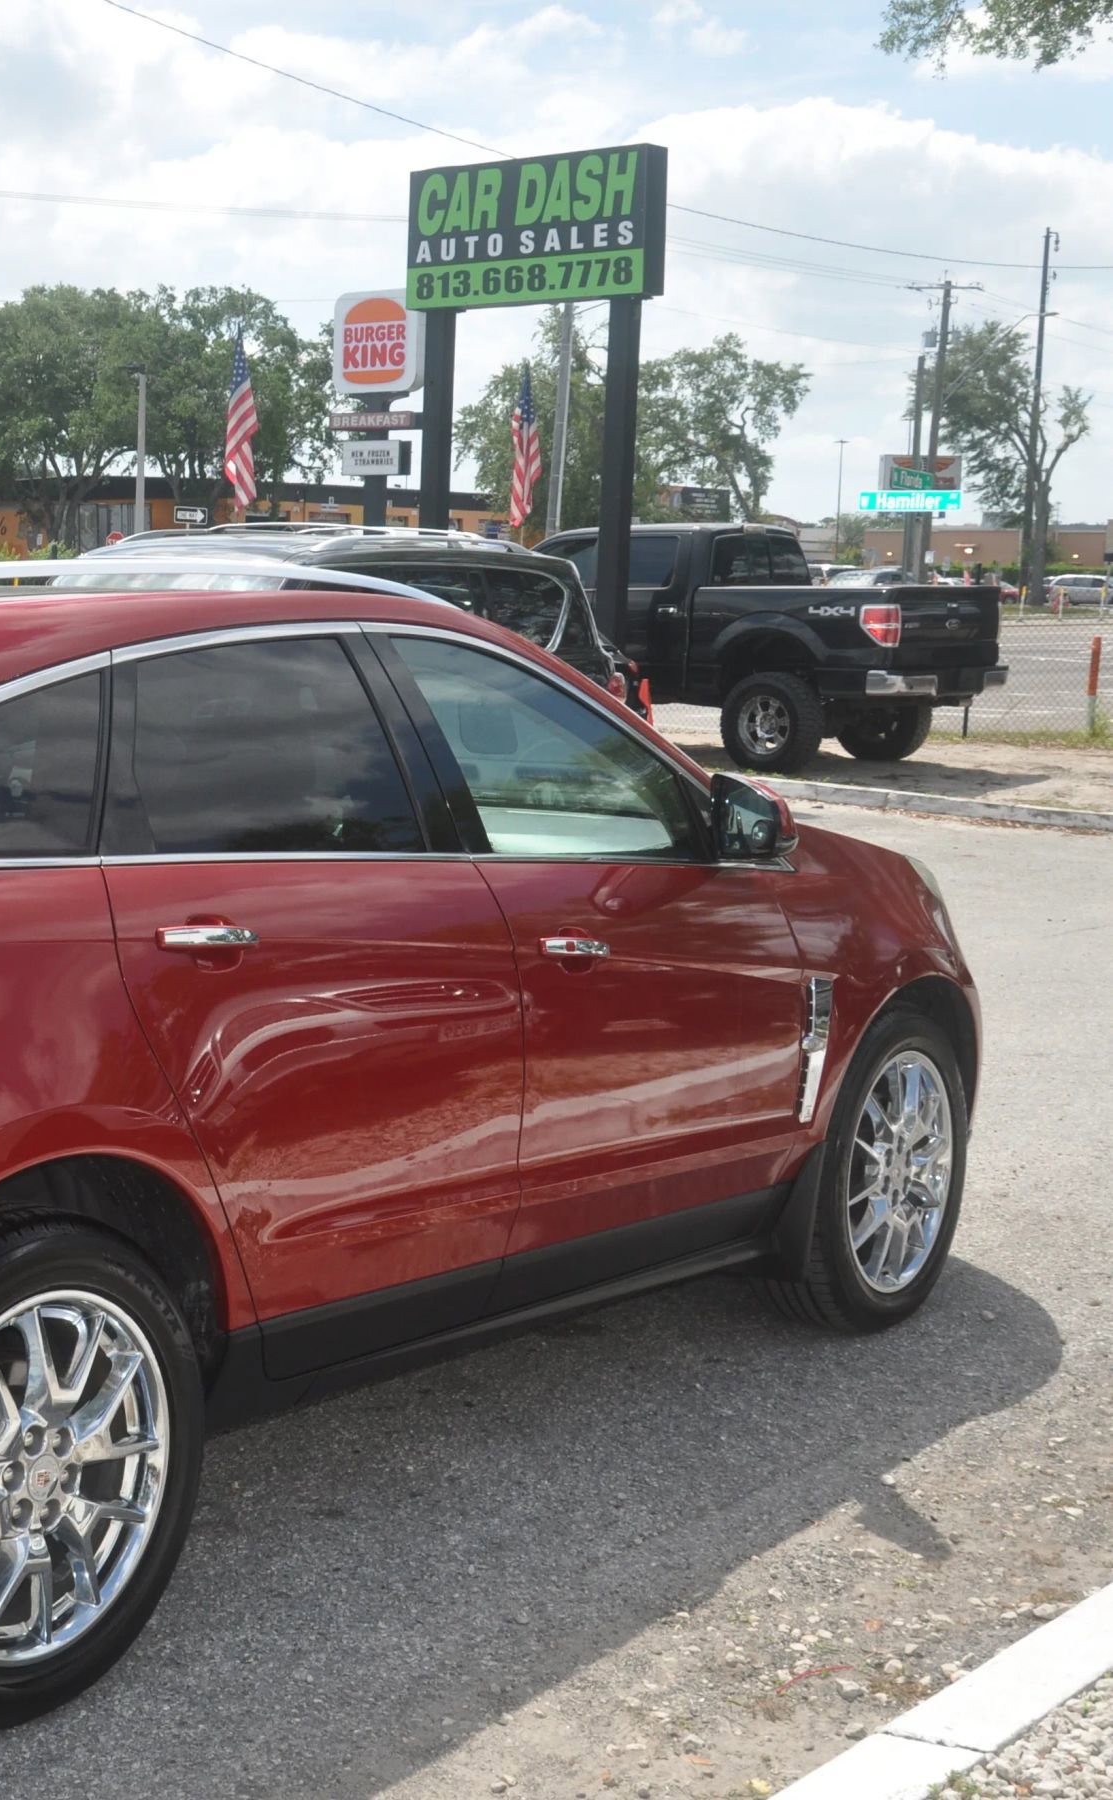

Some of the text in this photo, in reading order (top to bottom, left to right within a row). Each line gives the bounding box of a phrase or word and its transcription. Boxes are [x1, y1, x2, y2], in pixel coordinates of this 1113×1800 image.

[417, 151, 639, 237] CAR DASH
[415, 220, 633, 264] AUTO SALES
[416, 256, 633, 299] 813.668.7778
[343, 323, 407, 344] BURGER
[342, 342, 405, 369] KING
[333, 414, 406, 427] BREAKFAST
[808, 606, 856, 616] 4X4
